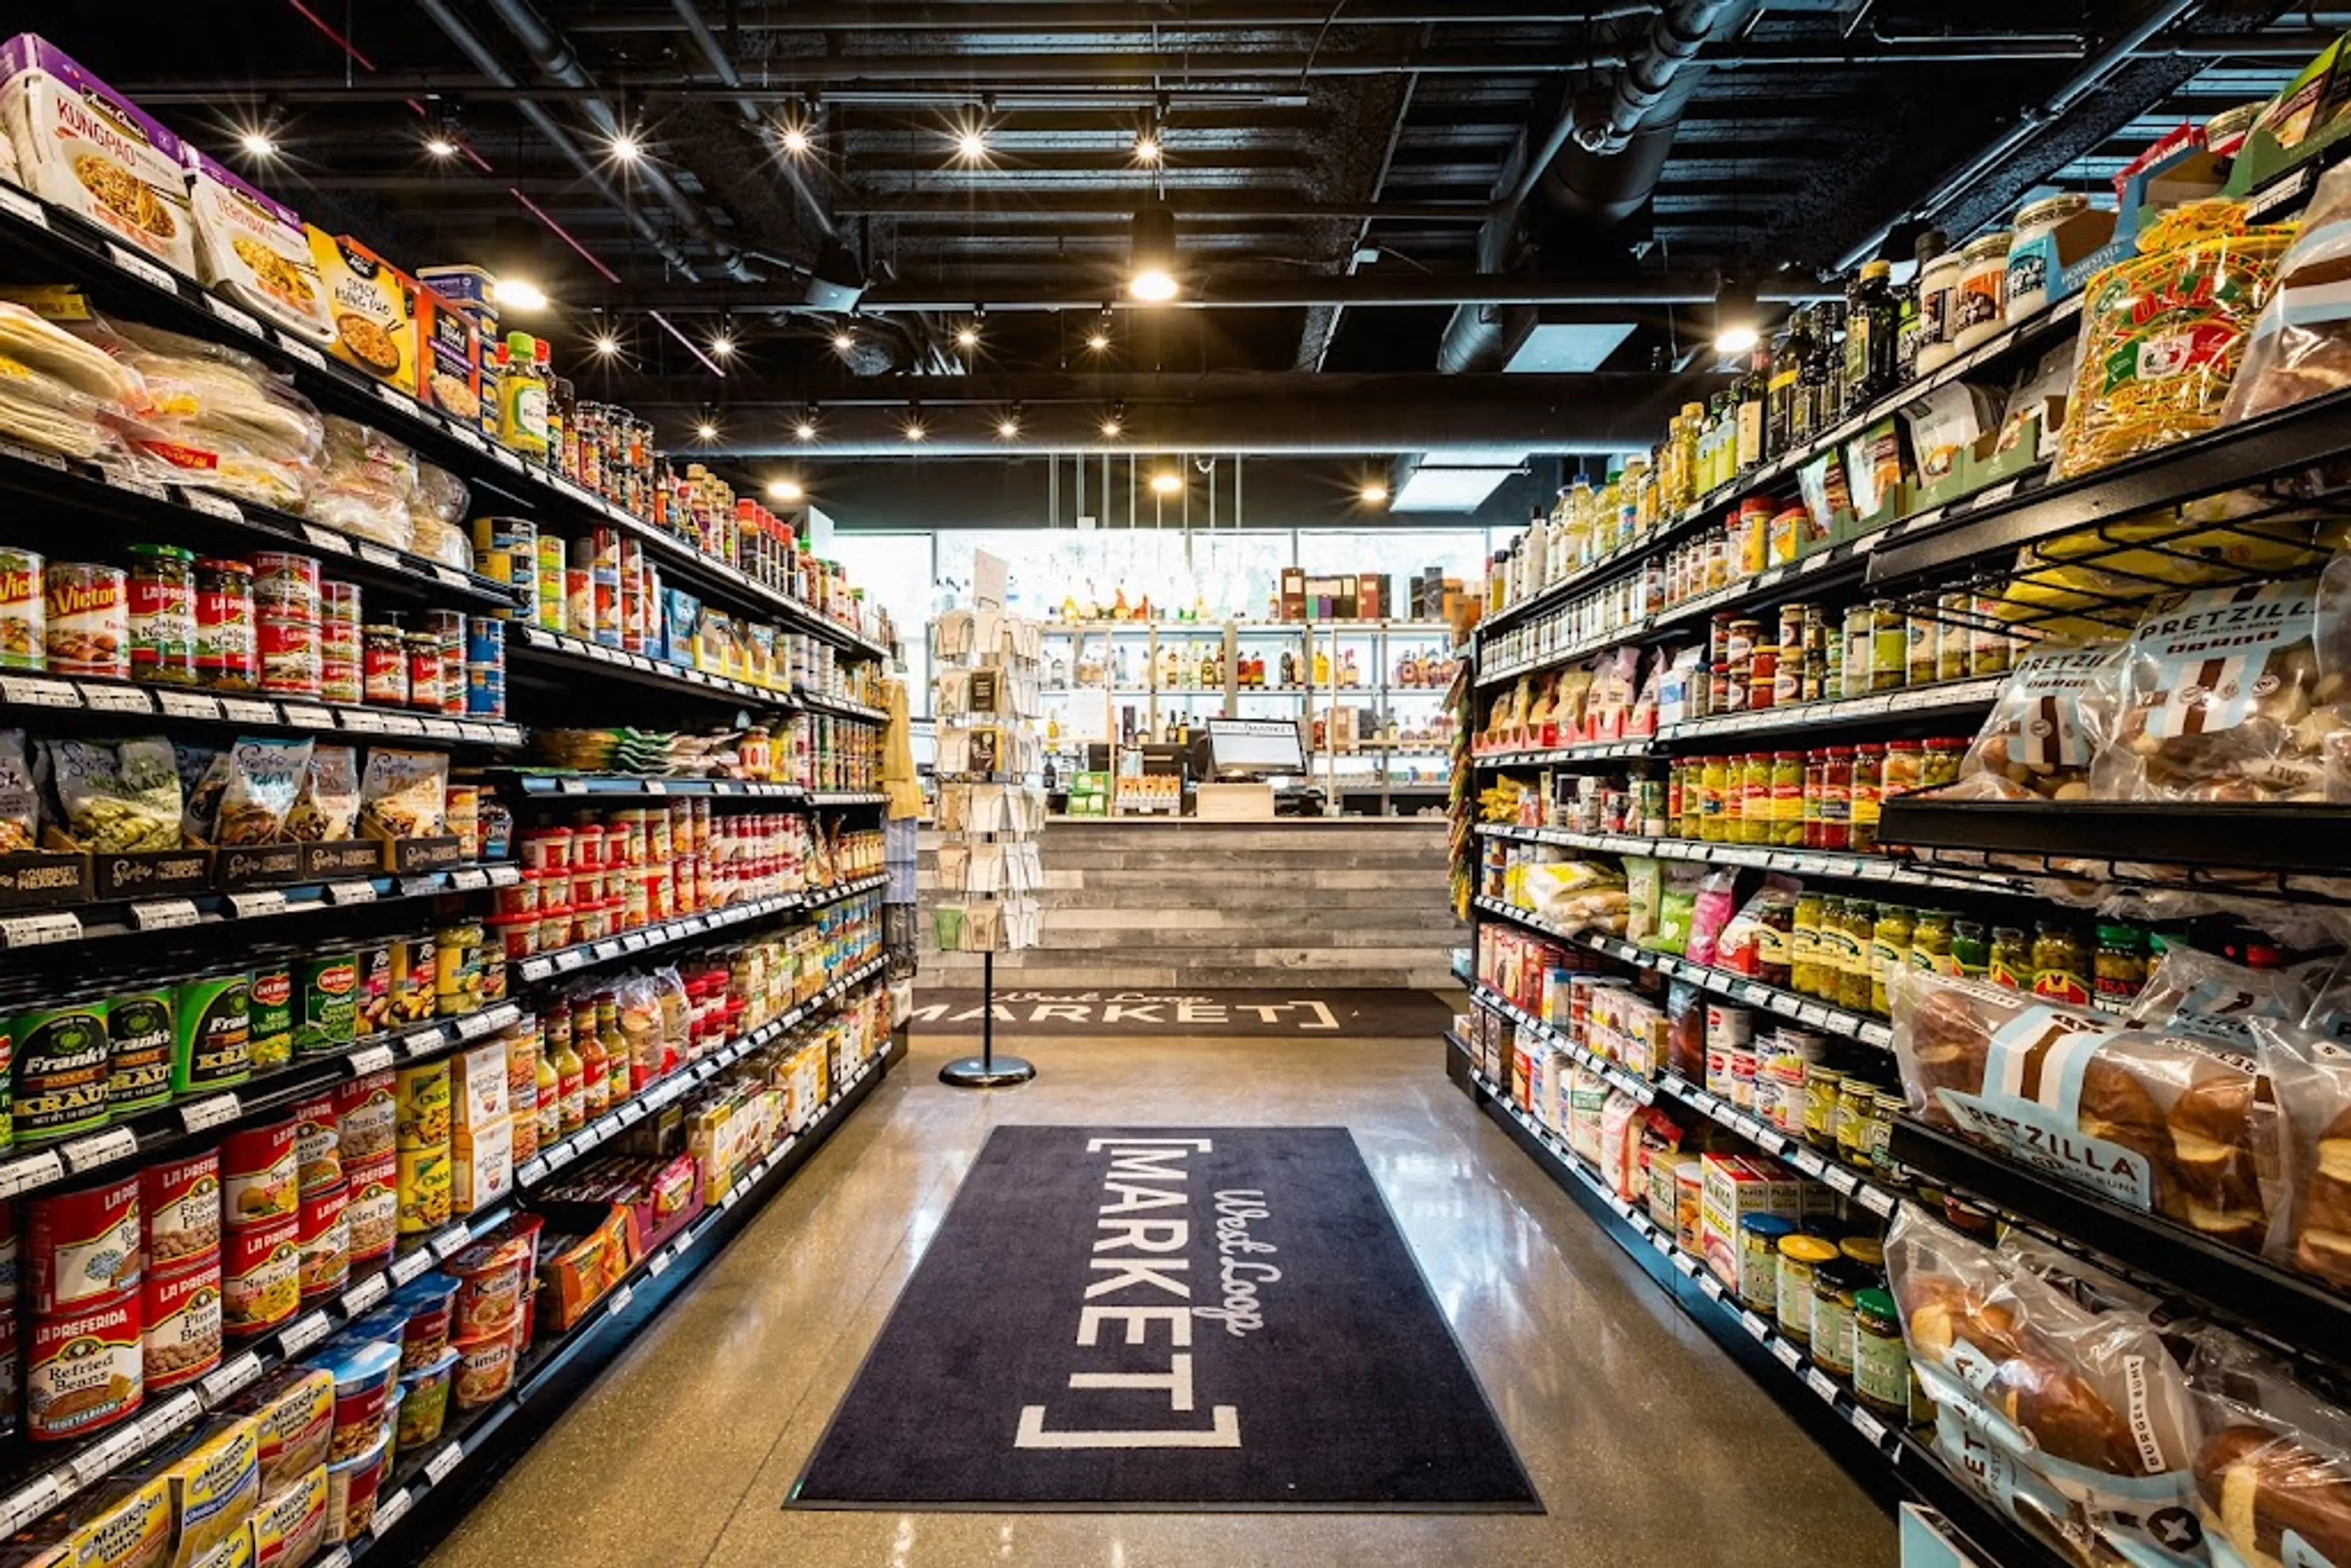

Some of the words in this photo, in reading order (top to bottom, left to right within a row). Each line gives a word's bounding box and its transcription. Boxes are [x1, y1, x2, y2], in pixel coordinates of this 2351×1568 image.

[2139, 601, 2315, 641] PRETZILL
[2265, 763, 2311, 787] SALT
[209, 1015, 250, 1034] Fran
[1213, 1189, 1279, 1255] West
[160, 1285, 177, 1303] LA
[1191, 1255, 1282, 1337] Loop
[36, 1326, 50, 1345] LA
[51, 1308, 127, 1340] PREFERIDA
[48, 1354, 114, 1382] Refried
[54, 1370, 110, 1394] Beans
